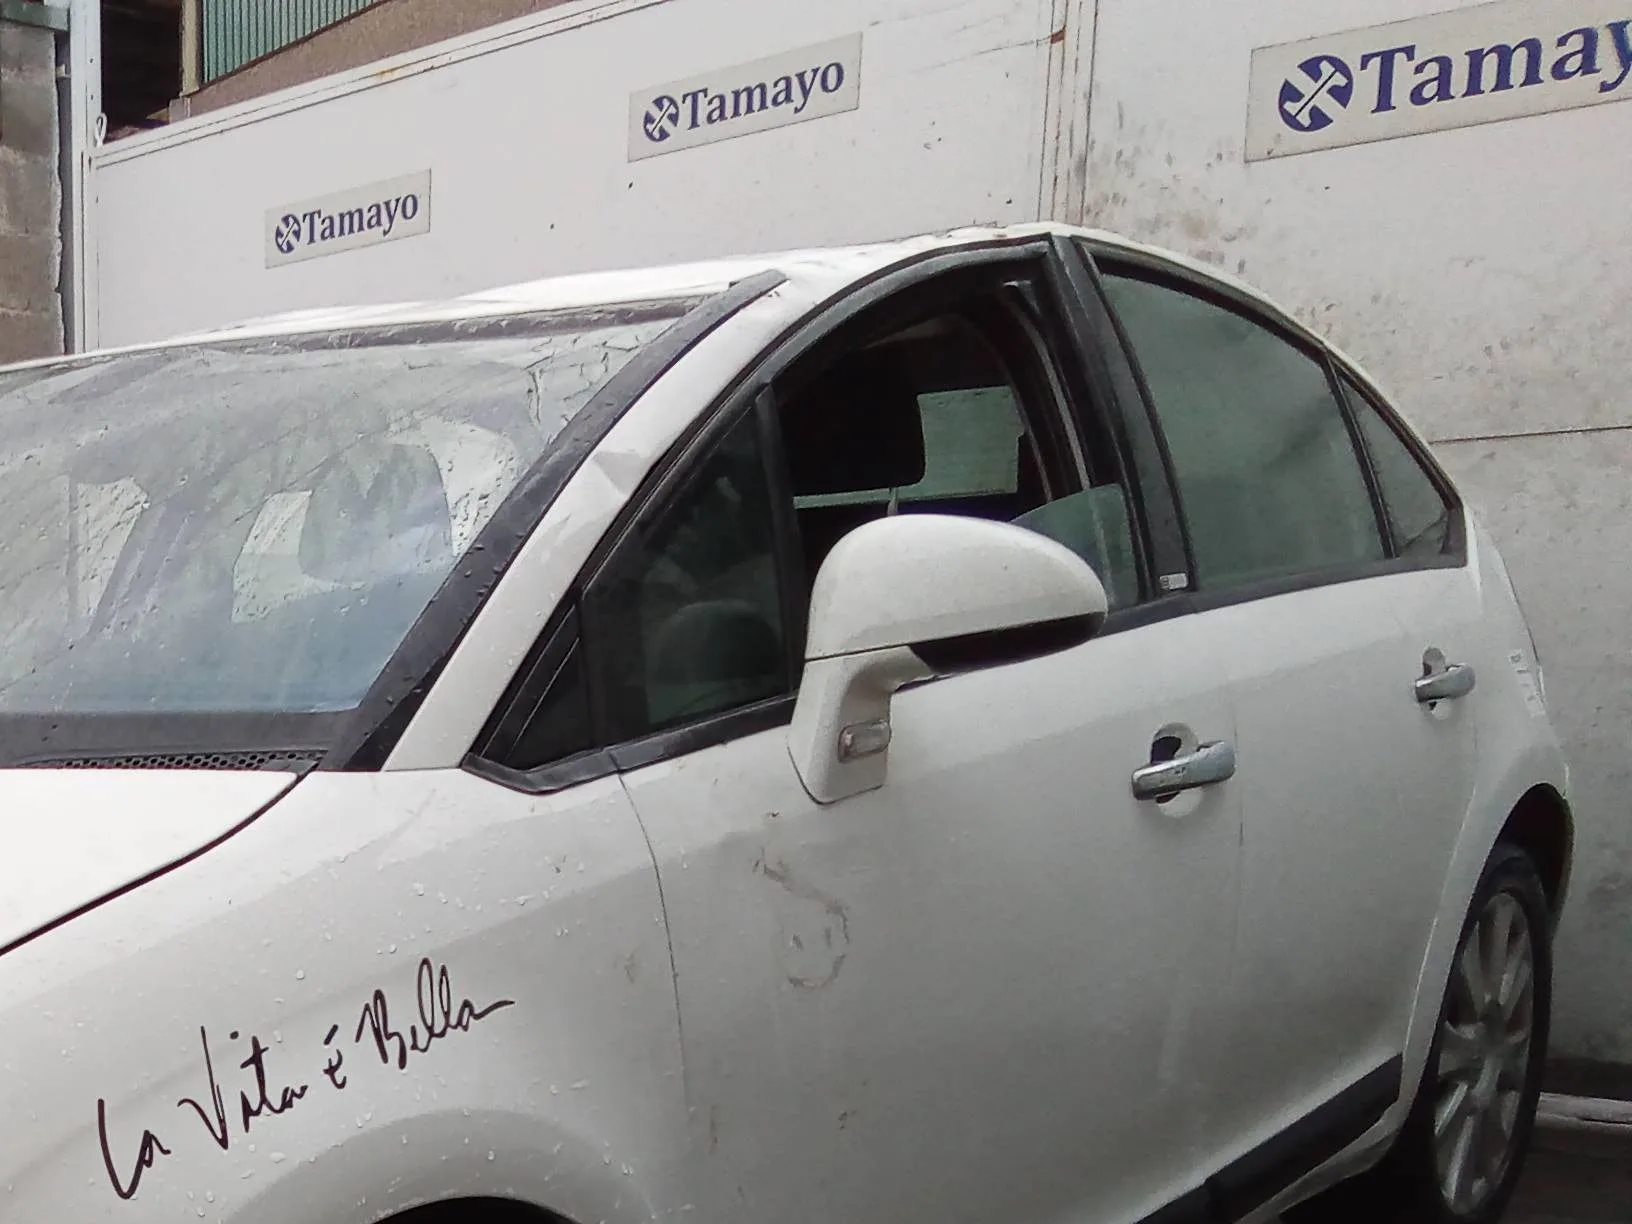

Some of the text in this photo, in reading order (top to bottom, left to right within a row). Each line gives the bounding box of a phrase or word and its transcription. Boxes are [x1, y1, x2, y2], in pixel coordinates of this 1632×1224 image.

[682, 61, 844, 130] Tamayo
[302, 193, 418, 245] Tamayo
[178, 1025, 308, 1150] Vita
[355, 957, 515, 1070] Bella
